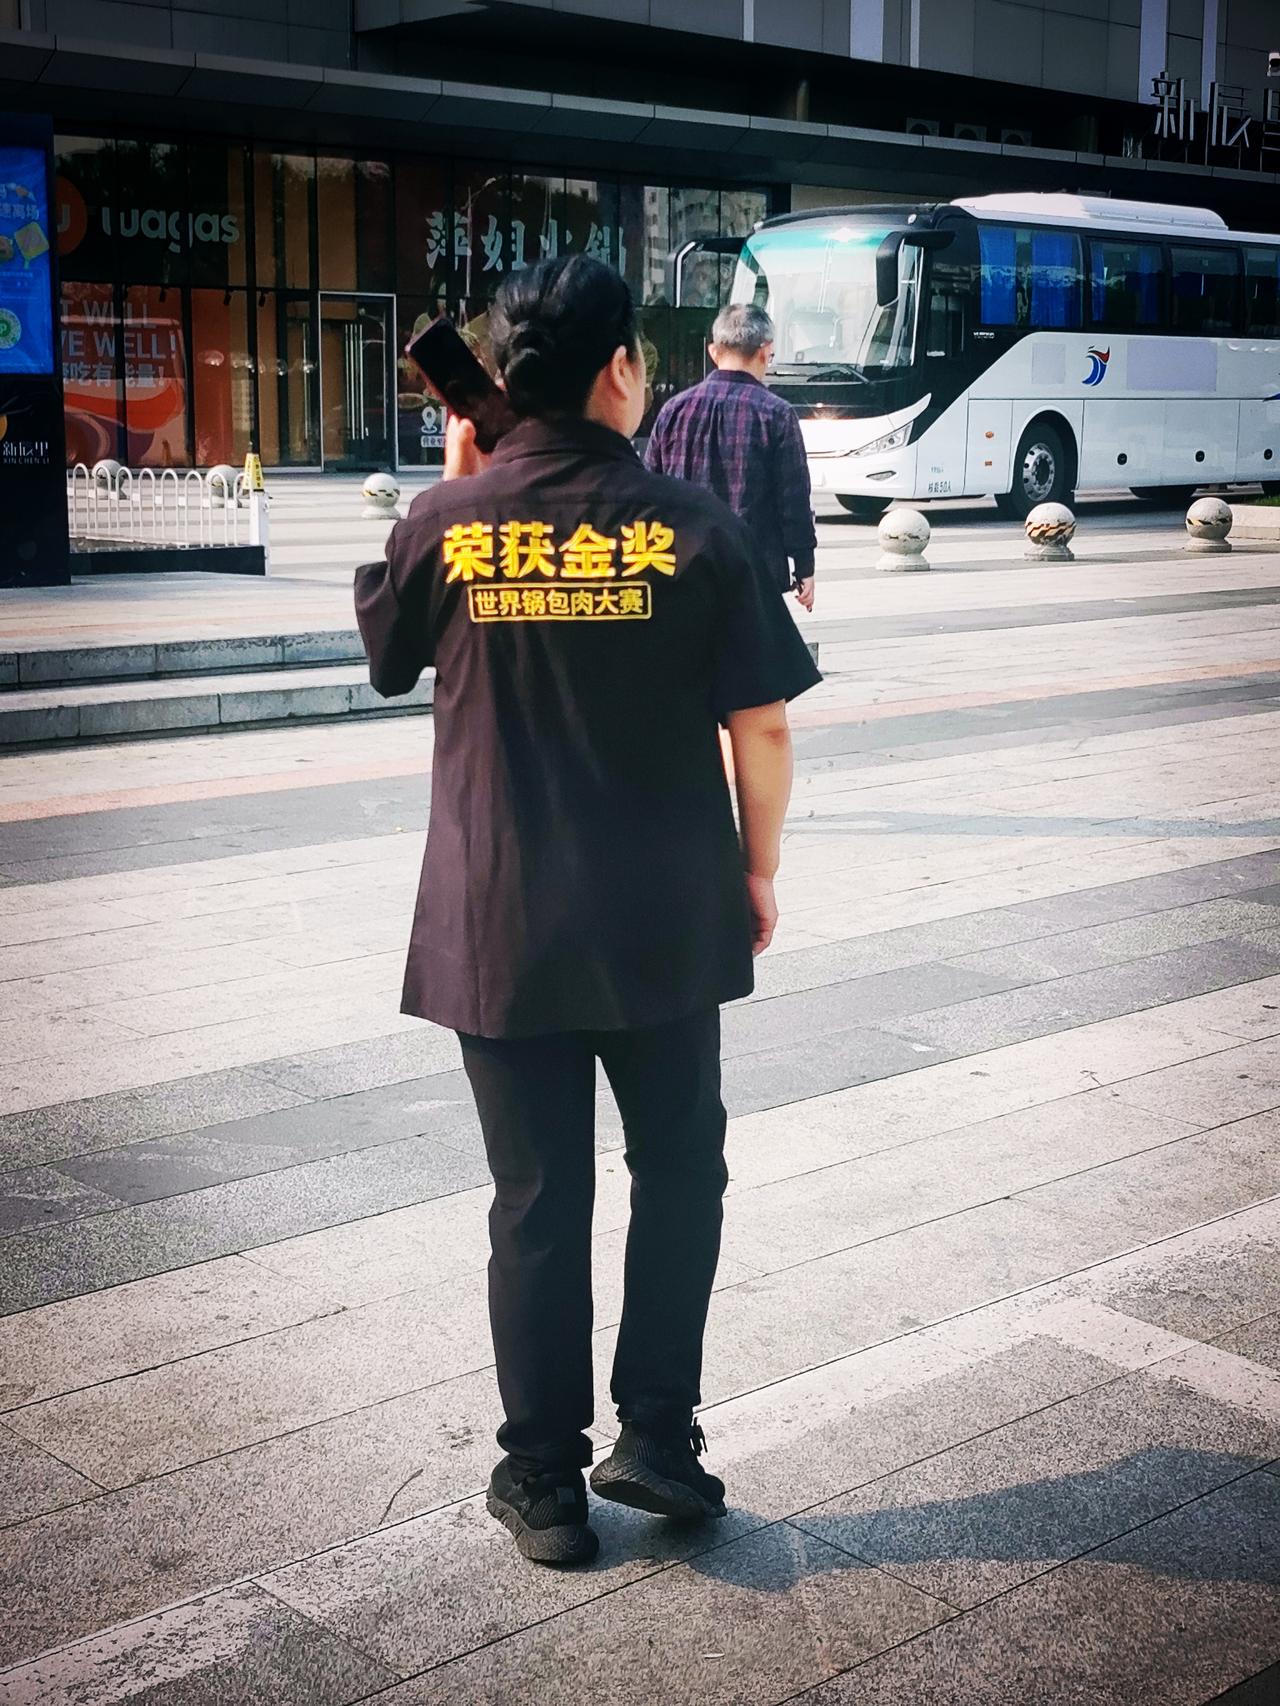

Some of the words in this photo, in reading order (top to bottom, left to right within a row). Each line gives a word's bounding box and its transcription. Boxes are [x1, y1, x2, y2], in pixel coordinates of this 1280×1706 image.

[442, 520, 677, 584] 荣获金奖
[474, 588, 644, 616] 世界锅包肉大赛
